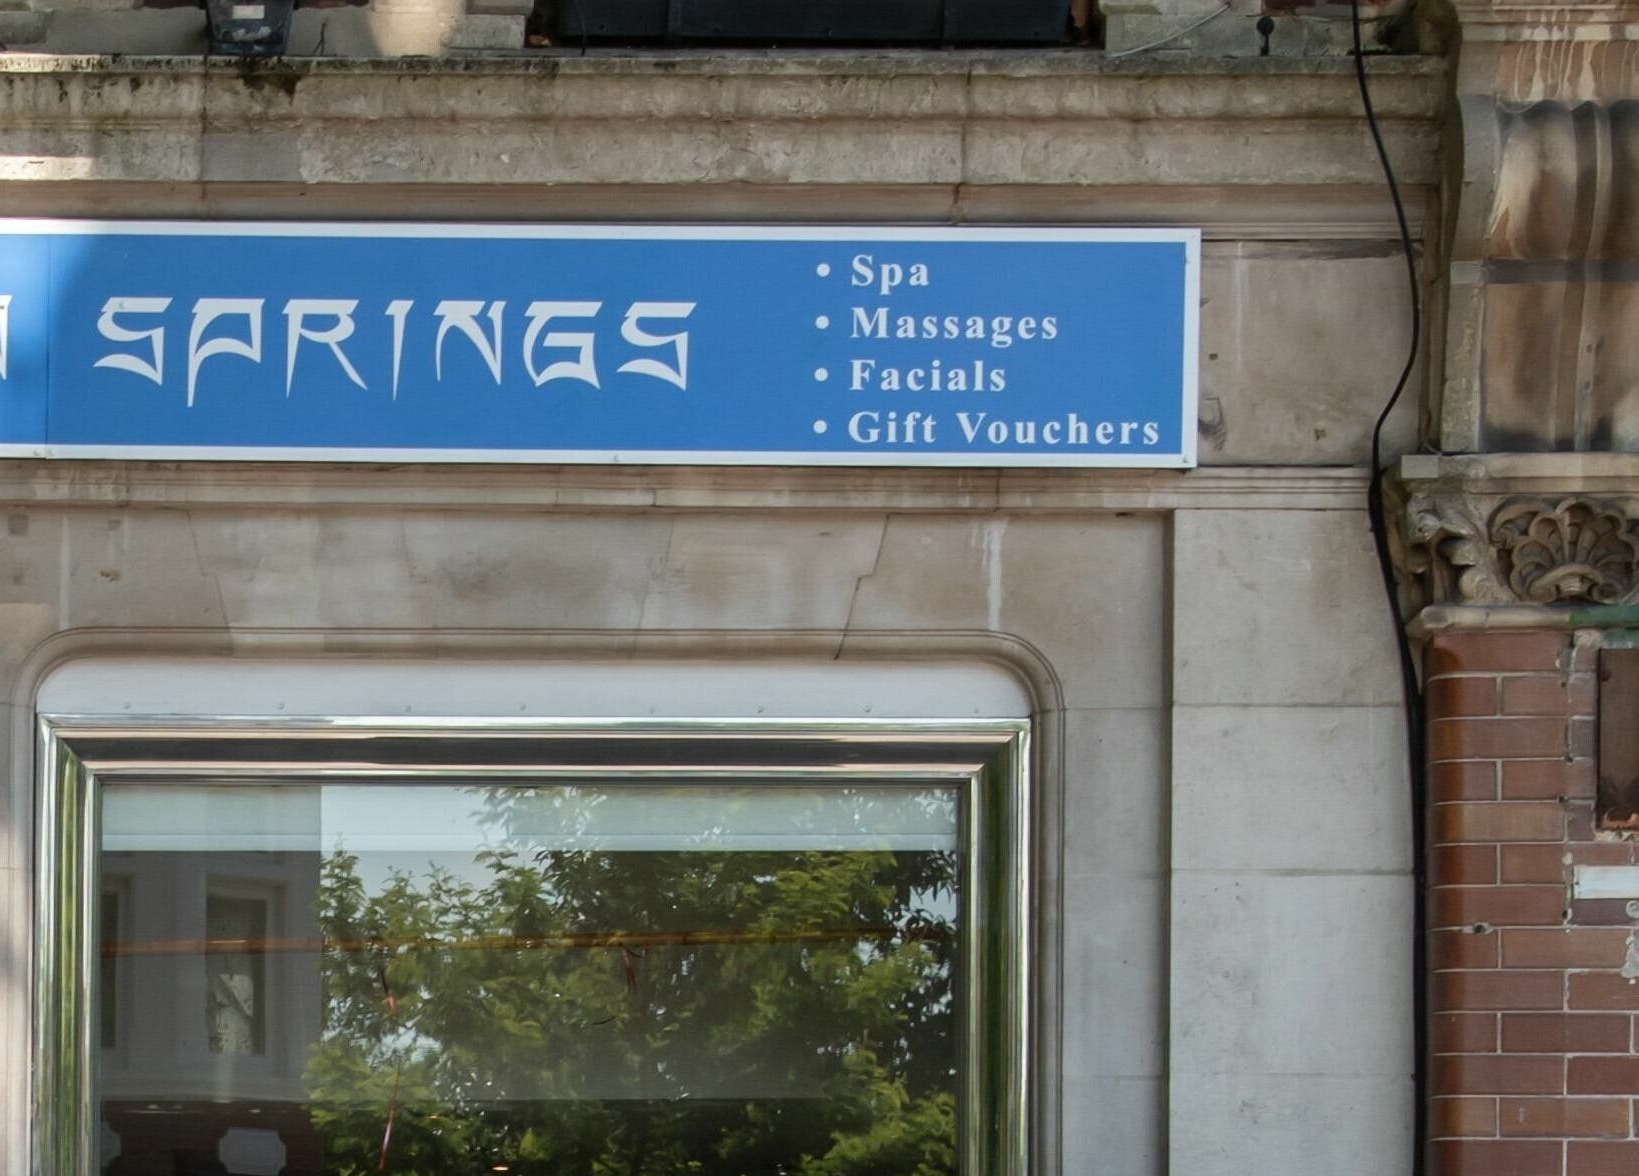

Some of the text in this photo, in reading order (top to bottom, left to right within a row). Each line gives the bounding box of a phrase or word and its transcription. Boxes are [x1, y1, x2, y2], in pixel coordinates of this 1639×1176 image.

[850, 254, 930, 295] Spa
[850, 307, 1058, 348] Massages
[93, 296, 697, 407] SPRINGS
[849, 359, 1007, 392] Facials
[848, 411, 1160, 445] Gift Vouchers
